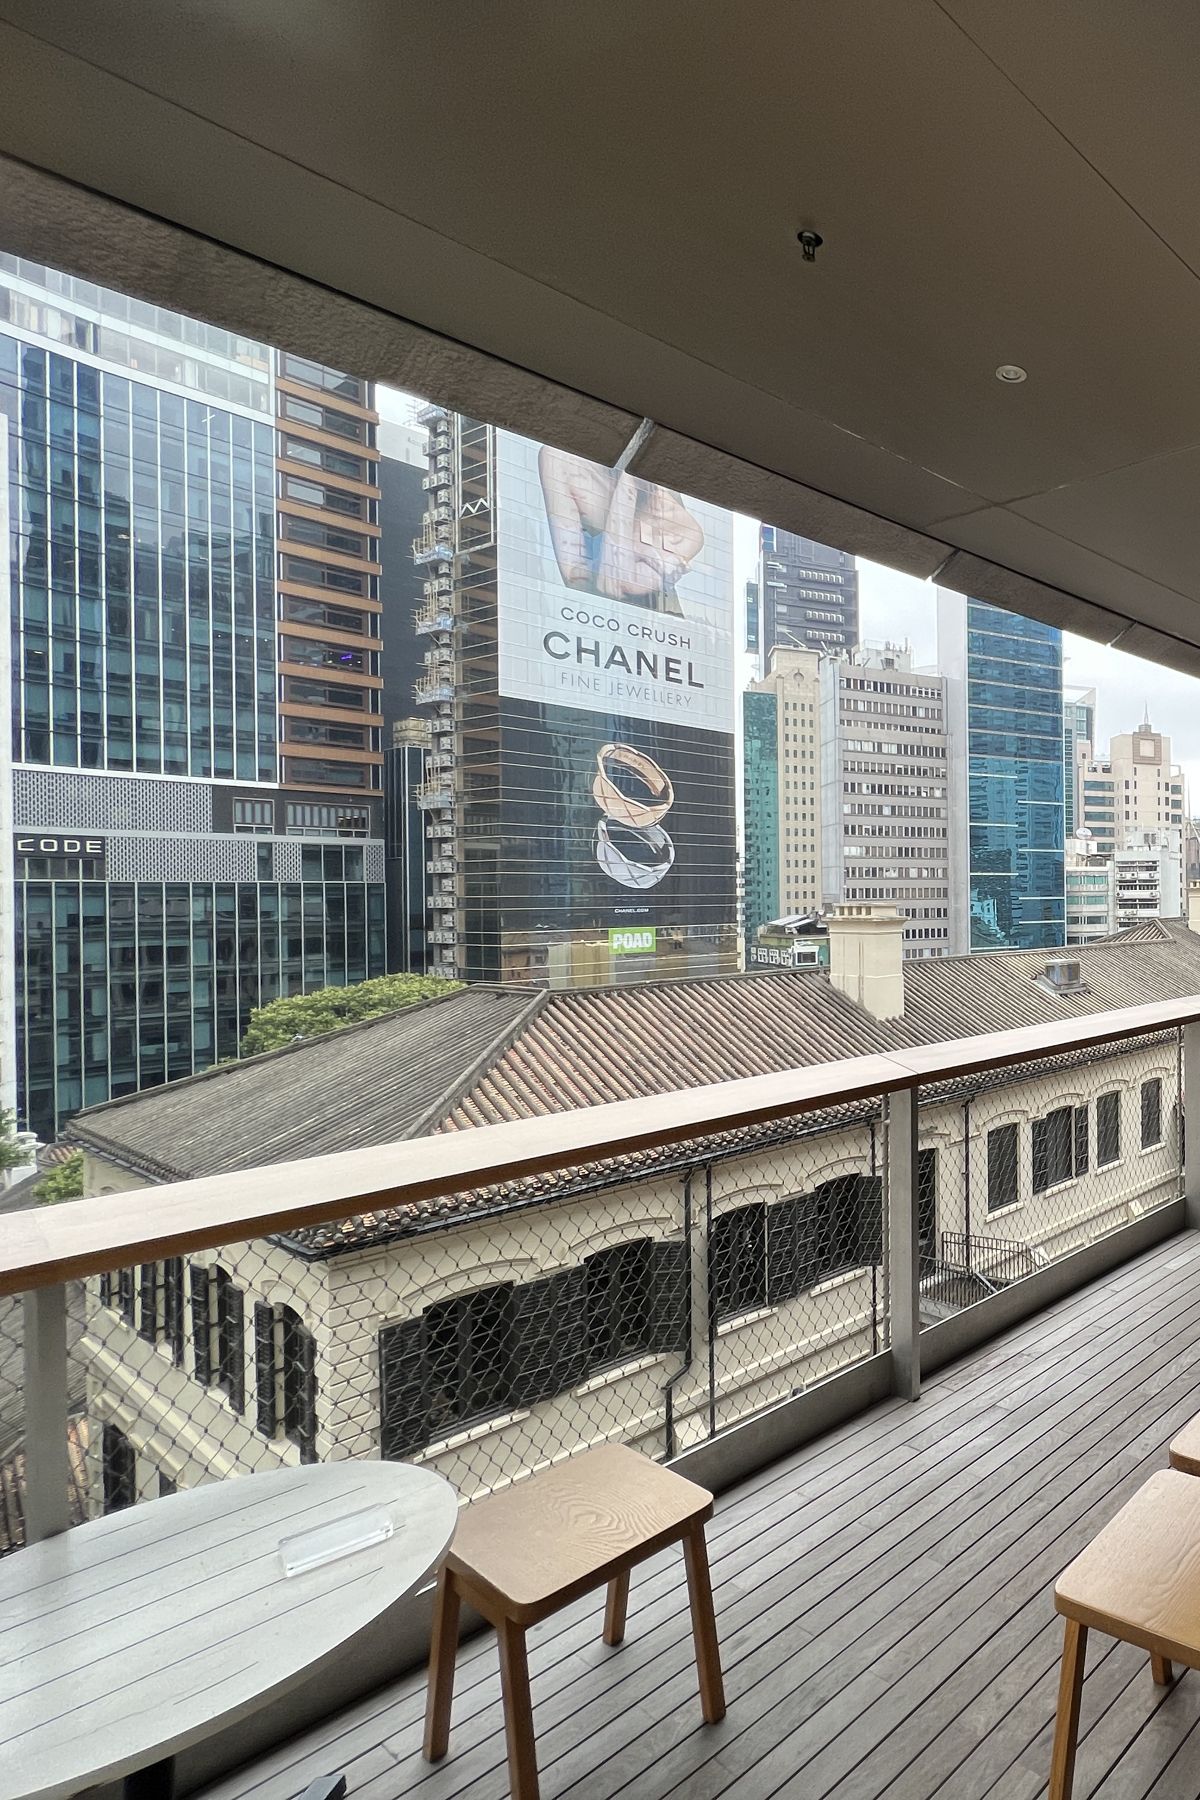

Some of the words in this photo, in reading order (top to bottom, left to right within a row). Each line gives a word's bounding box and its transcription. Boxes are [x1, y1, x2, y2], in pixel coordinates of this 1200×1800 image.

[560, 607, 620, 632] COCO
[627, 623, 691, 649] CRUSH
[543, 631, 704, 689] CHANEL
[561, 672, 600, 691] FINE
[608, 682, 692, 707] JEWELLERY
[17, 838, 102, 853] CODE
[612, 932, 653, 949] POAD
